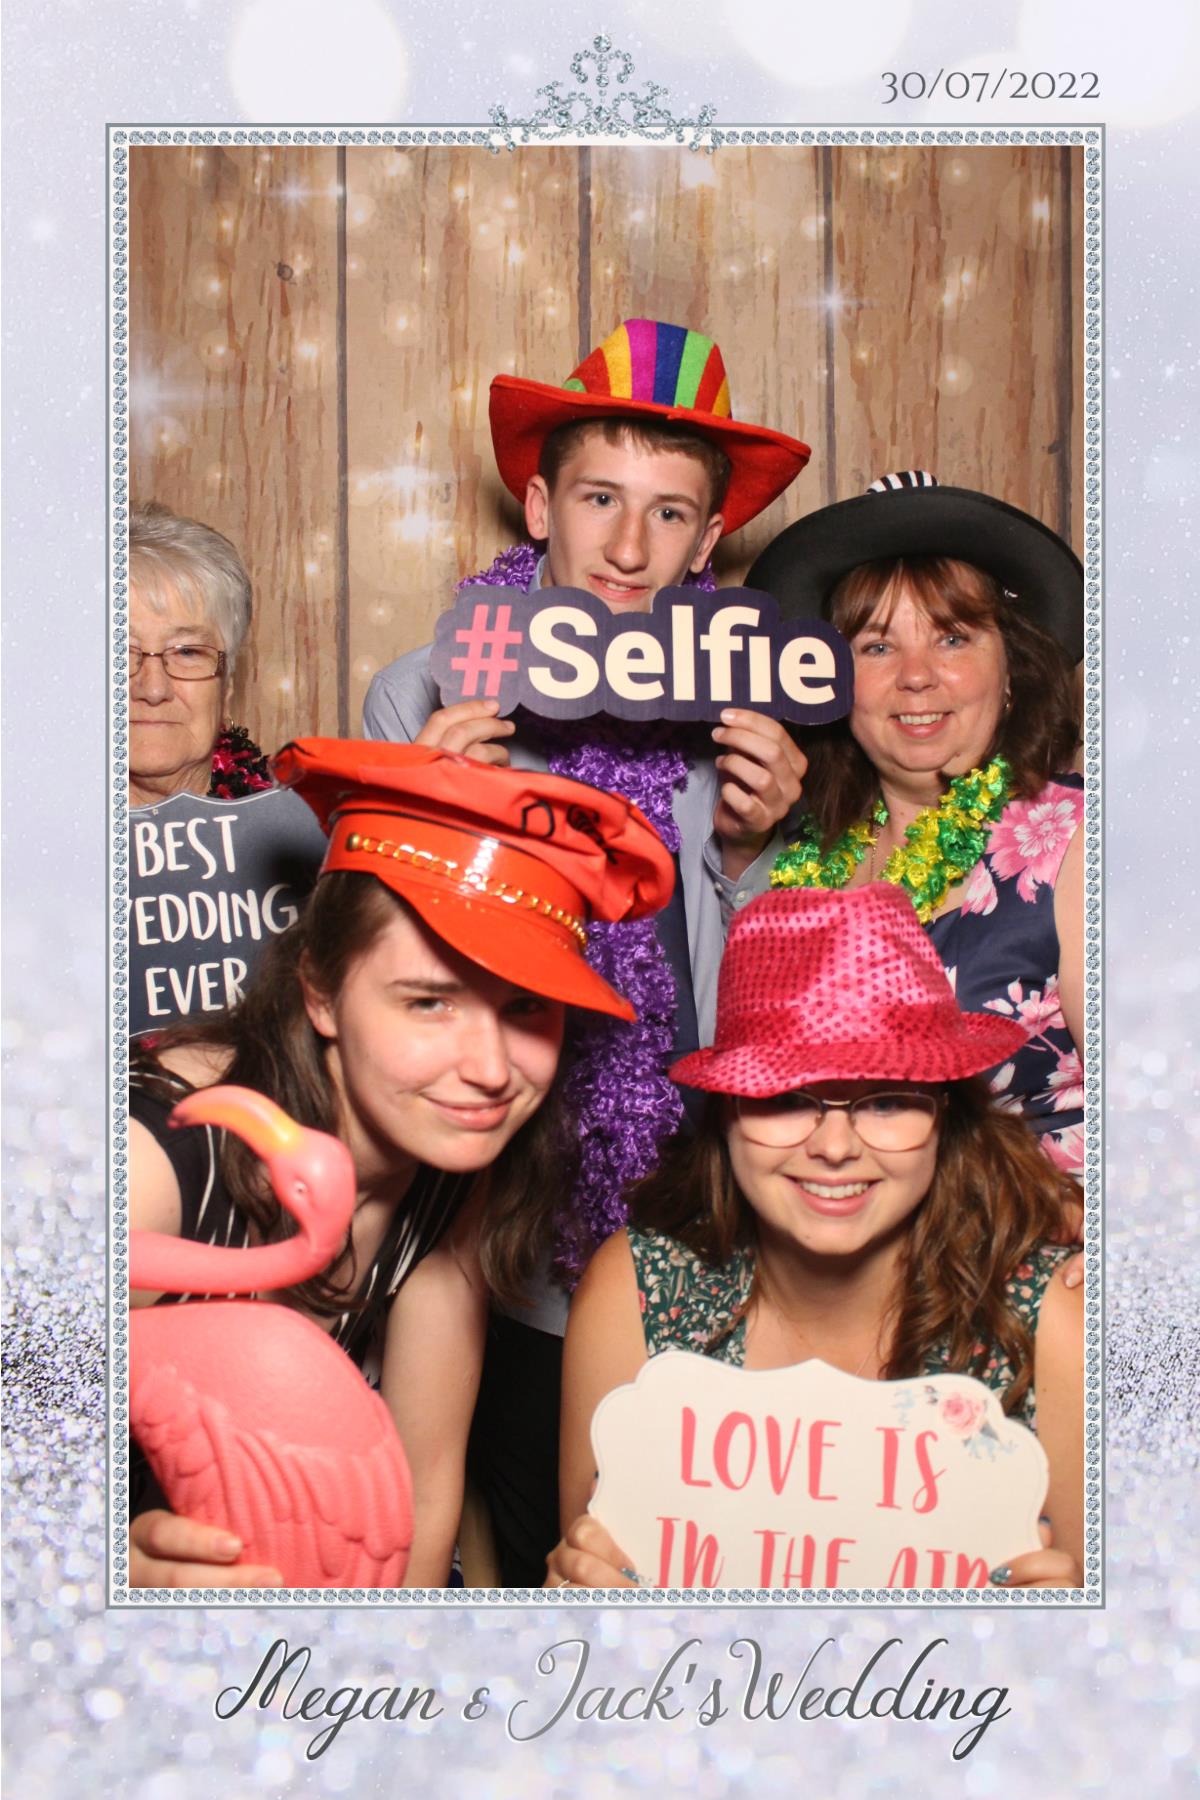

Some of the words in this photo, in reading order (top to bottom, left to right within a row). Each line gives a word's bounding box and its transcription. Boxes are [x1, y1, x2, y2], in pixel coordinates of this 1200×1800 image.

[450, 603, 837, 706] #Selfie
[134, 814, 239, 880] BEST
[129, 883, 299, 946] EDDING
[144, 957, 248, 1017] EVER
[681, 1406, 842, 1502] LOVE
[875, 1426, 947, 1515] IS
[753, 1529, 857, 1588] THE
